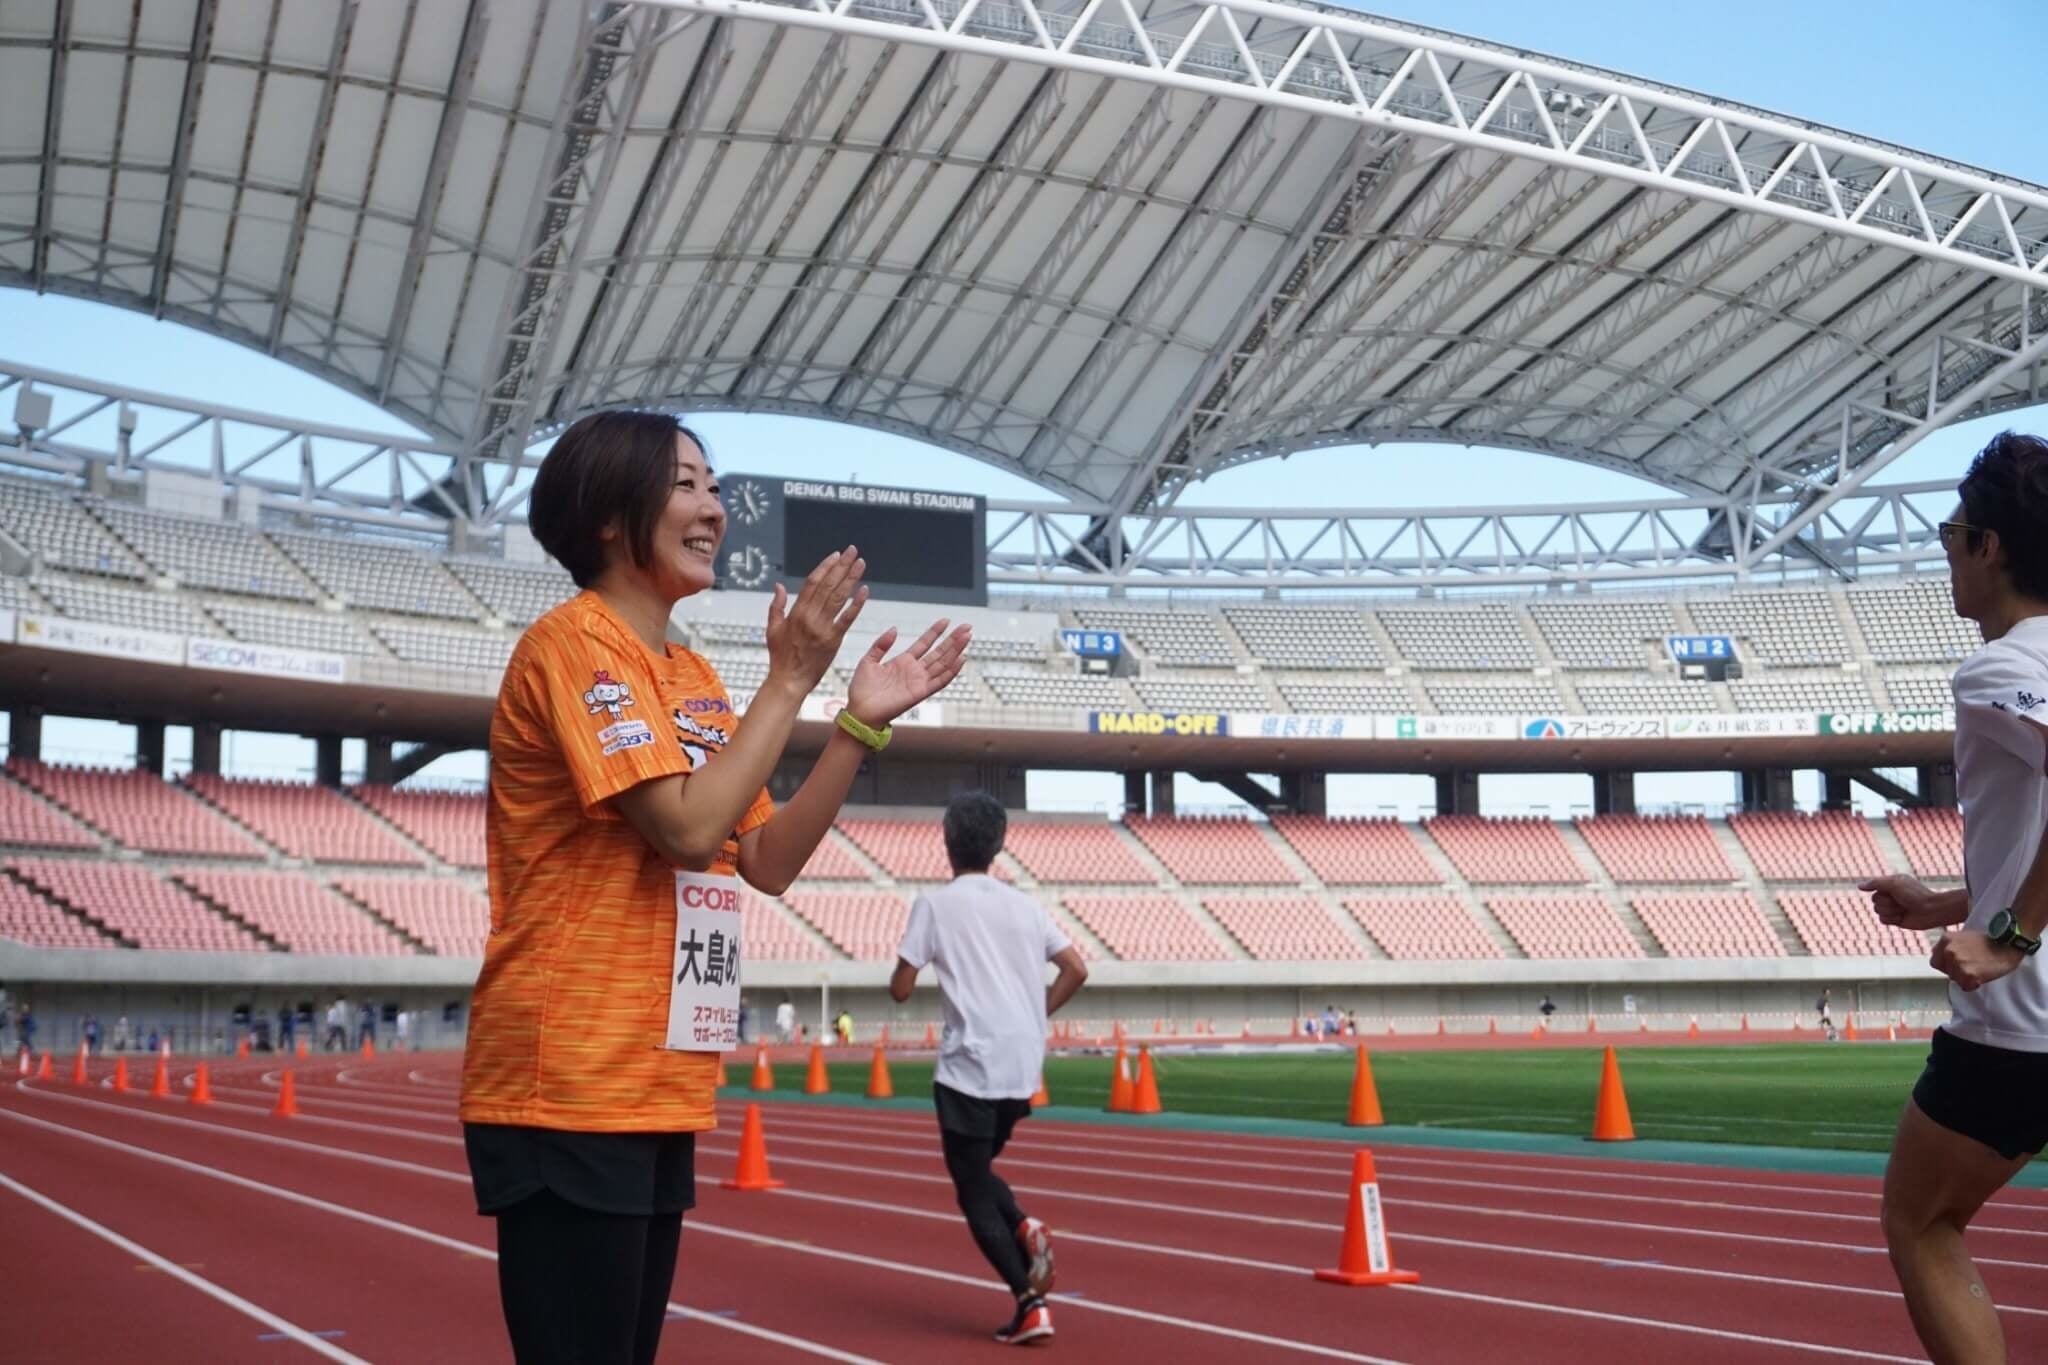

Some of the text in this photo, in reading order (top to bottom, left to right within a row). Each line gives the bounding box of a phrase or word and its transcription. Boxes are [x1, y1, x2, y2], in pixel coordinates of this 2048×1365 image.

[784, 480, 975, 511] DENKA BIG SWAN STADIUM
[1065, 634, 1115, 651] N 3
[1672, 639, 1724, 656] N 2
[191, 643, 257, 668] SECOM
[1568, 720, 1662, 737] アドヴァンス
[1829, 714, 1880, 735] OFF
[682, 885, 741, 912] COR
